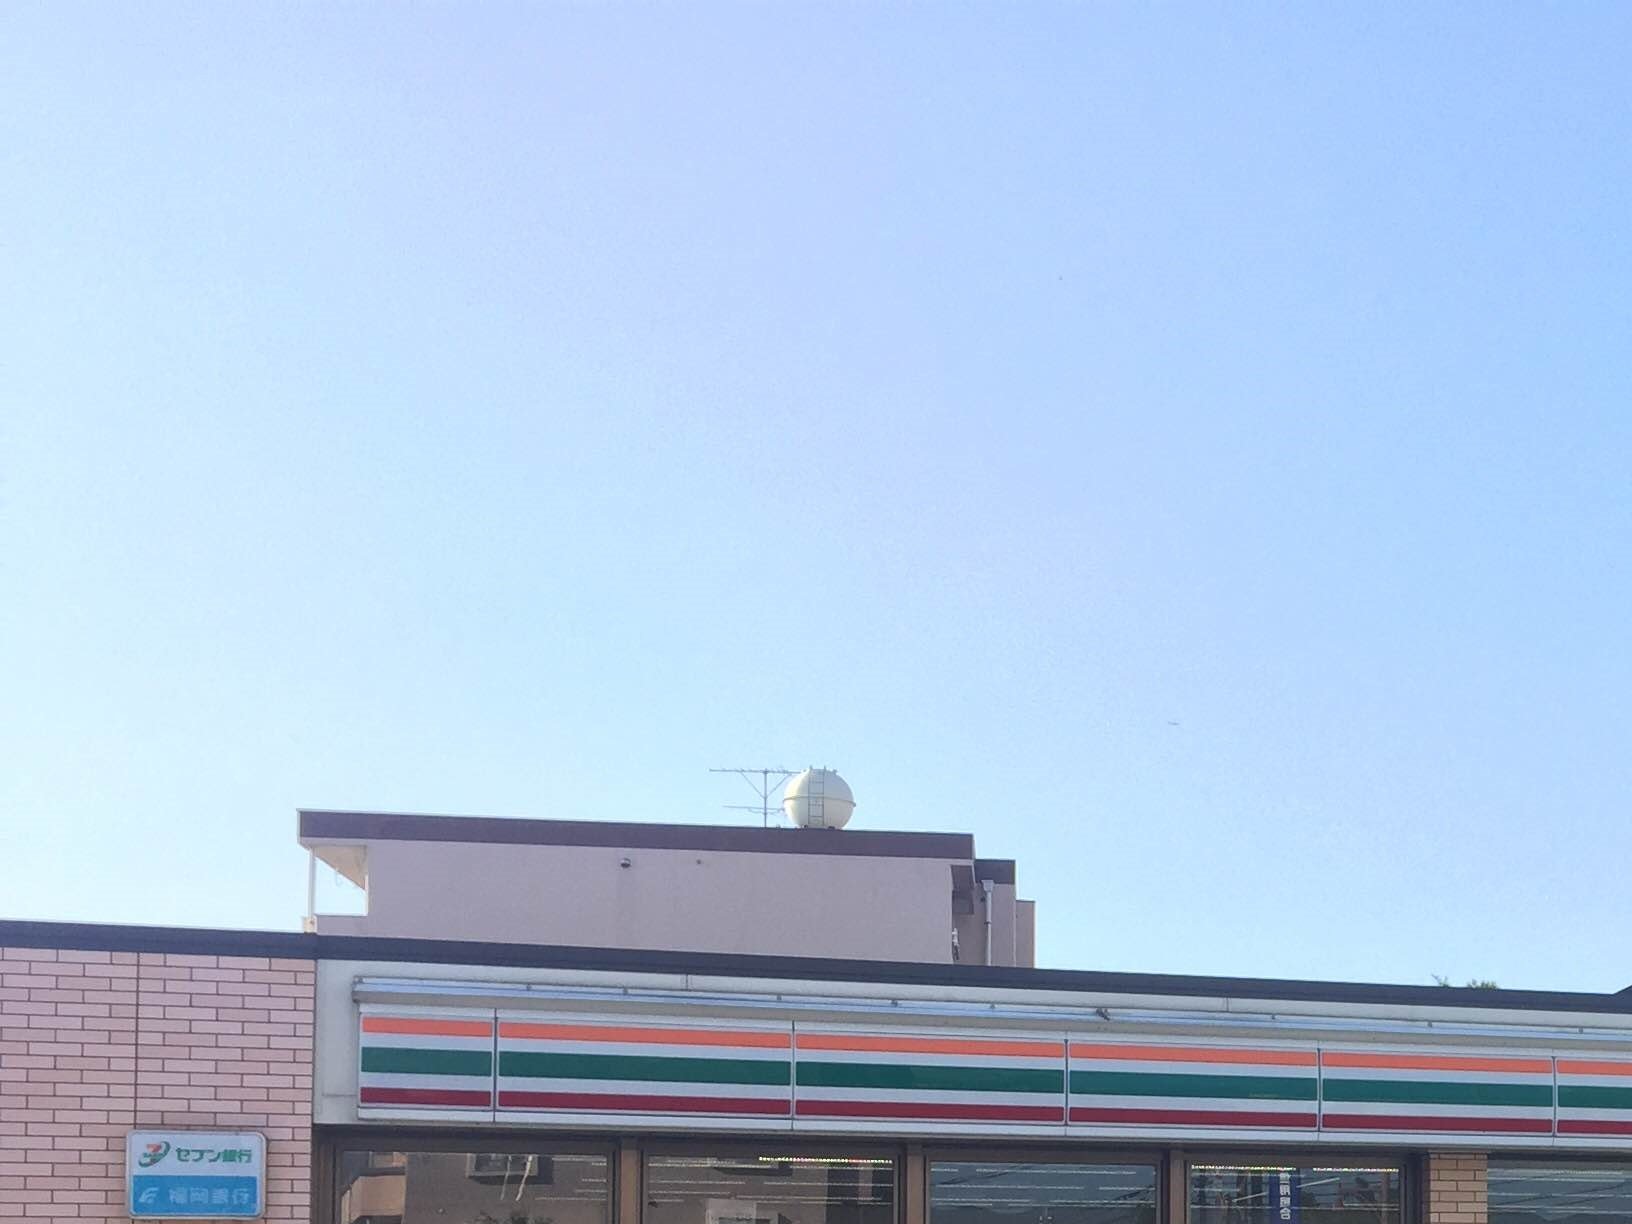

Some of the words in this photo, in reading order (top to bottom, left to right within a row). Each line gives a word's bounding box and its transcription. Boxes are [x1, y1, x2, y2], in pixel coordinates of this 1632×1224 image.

[176, 1147, 252, 1163] セブン銀行
